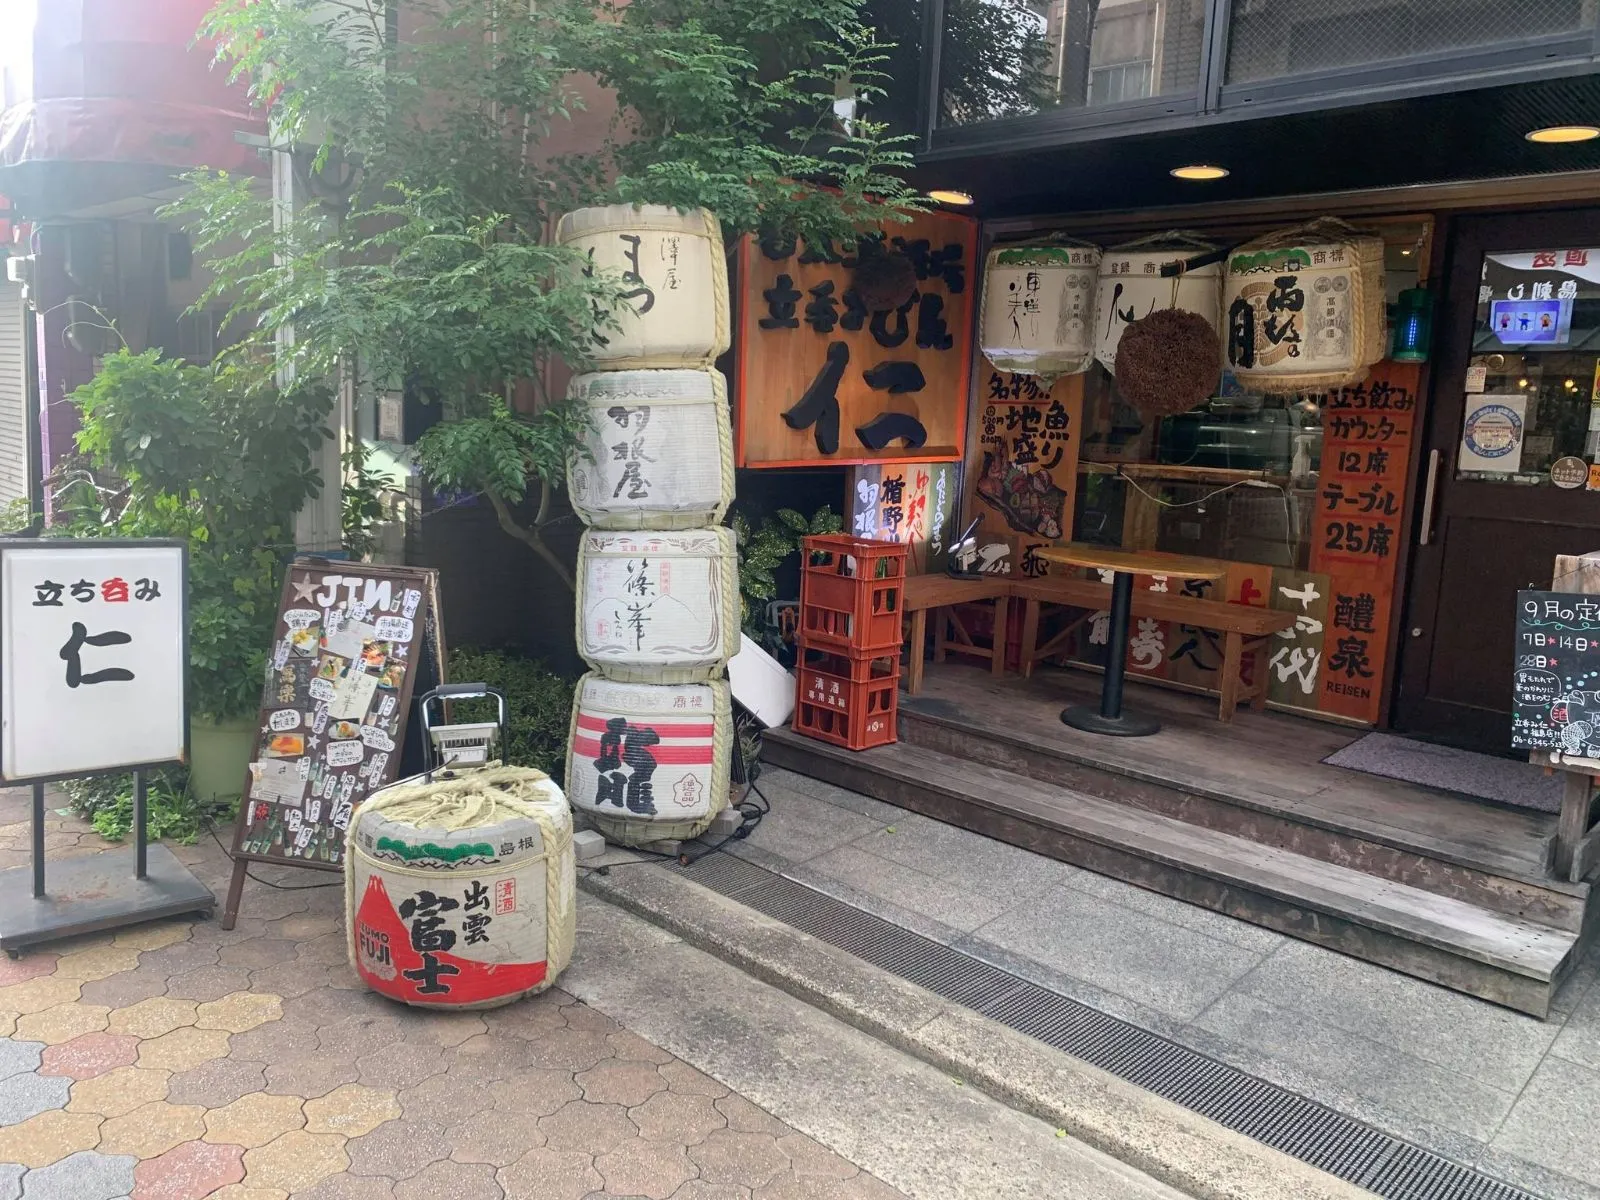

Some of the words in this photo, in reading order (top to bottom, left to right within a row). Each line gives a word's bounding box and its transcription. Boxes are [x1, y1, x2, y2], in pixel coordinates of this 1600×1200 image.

[780, 341, 928, 454] 仁
[1330, 416, 1408, 441] カウンター
[1338, 447, 1389, 476] 12席
[855, 478, 880, 540] 羽根
[1323, 483, 1399, 516] テーブル
[1325, 521, 1394, 557] 25席
[1524, 599, 1600, 622] 9月の定
[59, 621, 136, 689] 仁
[1522, 632, 1547, 647] 7日
[1559, 635, 1588, 651] 14日
[1519, 654, 1547, 668] 28日
[814, 676, 840, 694] 清酒
[498, 835, 534, 856] 島根
[462, 880, 492, 946] 出雲
[398, 889, 462, 995] 富士
